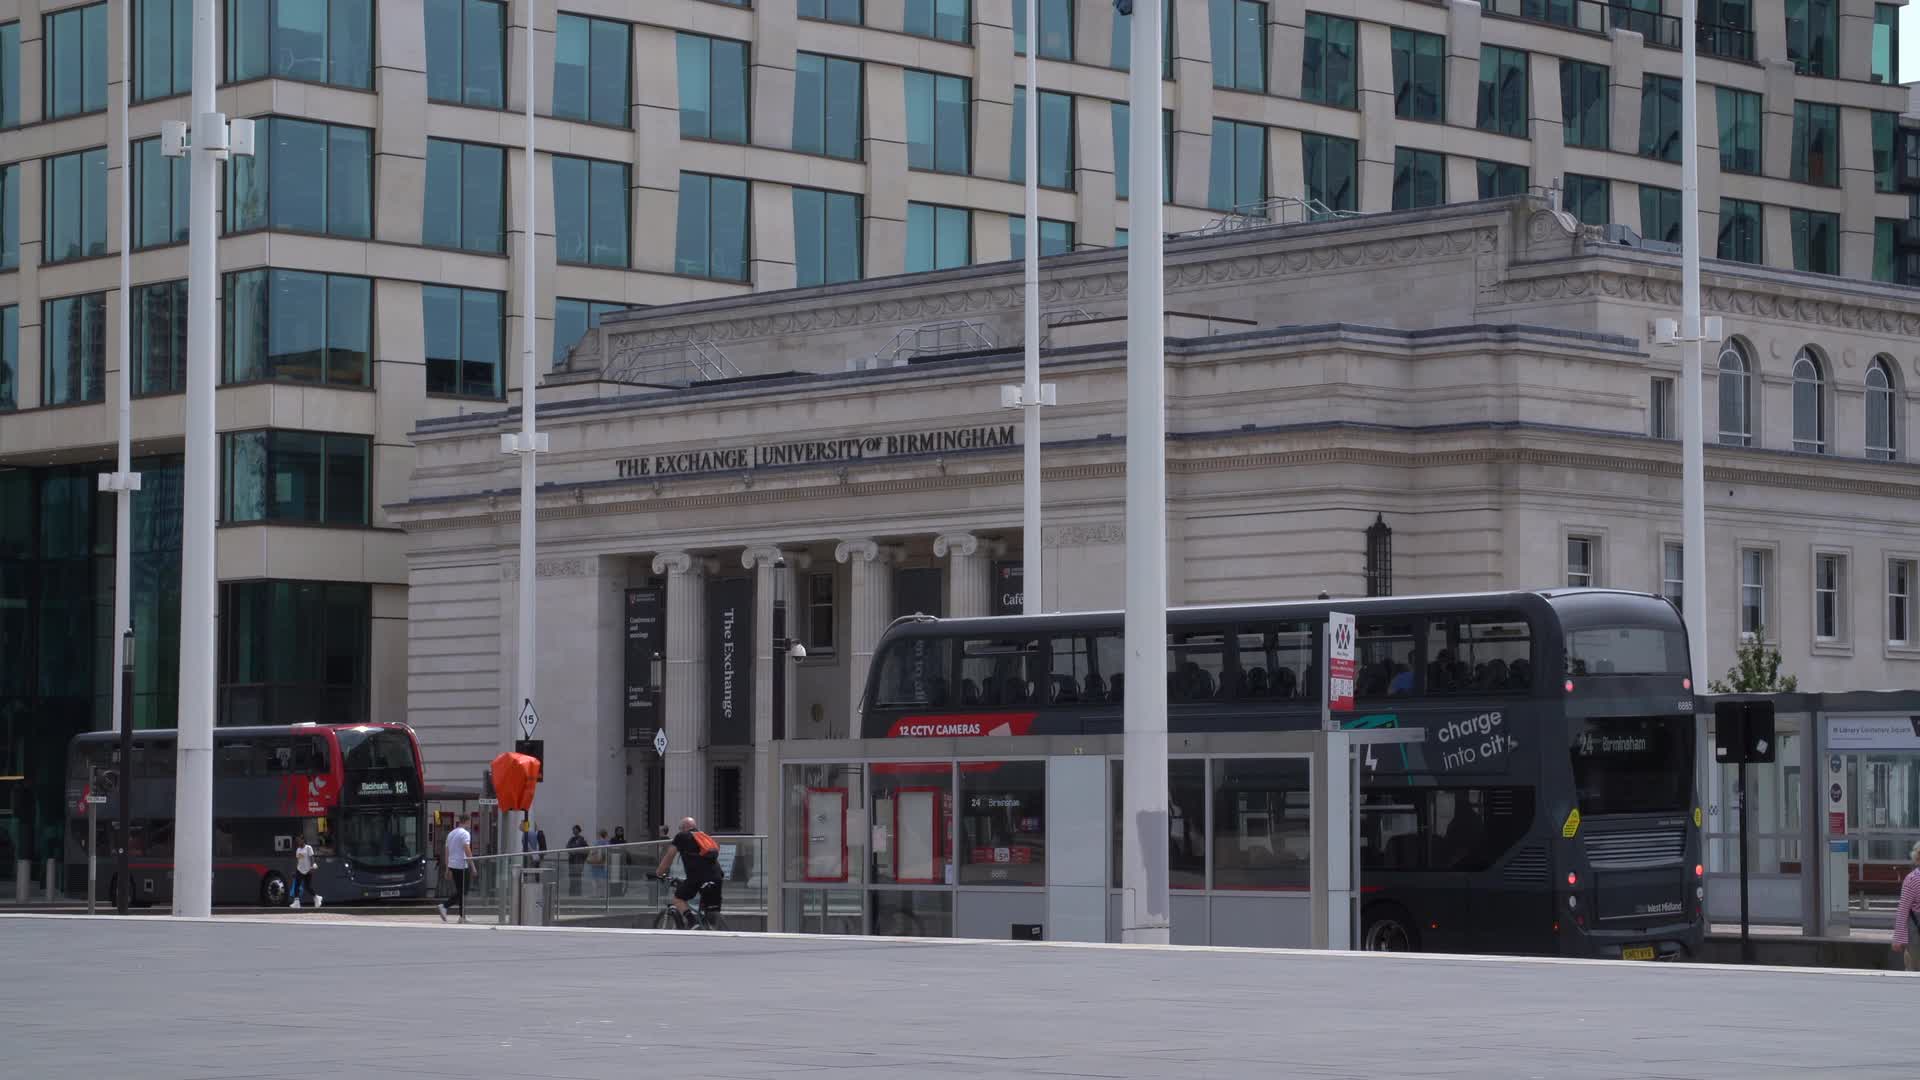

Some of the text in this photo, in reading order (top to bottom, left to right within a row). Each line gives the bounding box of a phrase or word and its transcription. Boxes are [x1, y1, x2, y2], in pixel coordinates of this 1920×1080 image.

[616, 457, 650, 478] THE
[655, 449, 748, 474] EXCHANGE
[762, 438, 868, 465] UNIVERSITY
[887, 425, 1015, 454] BIRMINGHAM
[722, 608, 734, 718] The Exchange
[524, 715, 534, 725] 15
[1438, 711, 1502, 742] charge
[899, 723, 981, 736] 12 CCTV CAMERAS
[656, 738, 665, 746] 15
[1443, 747, 1476, 769] into
[395, 781, 408, 794] 13A
[971, 799, 980, 807] 24
[1647, 904, 1661, 913] West
